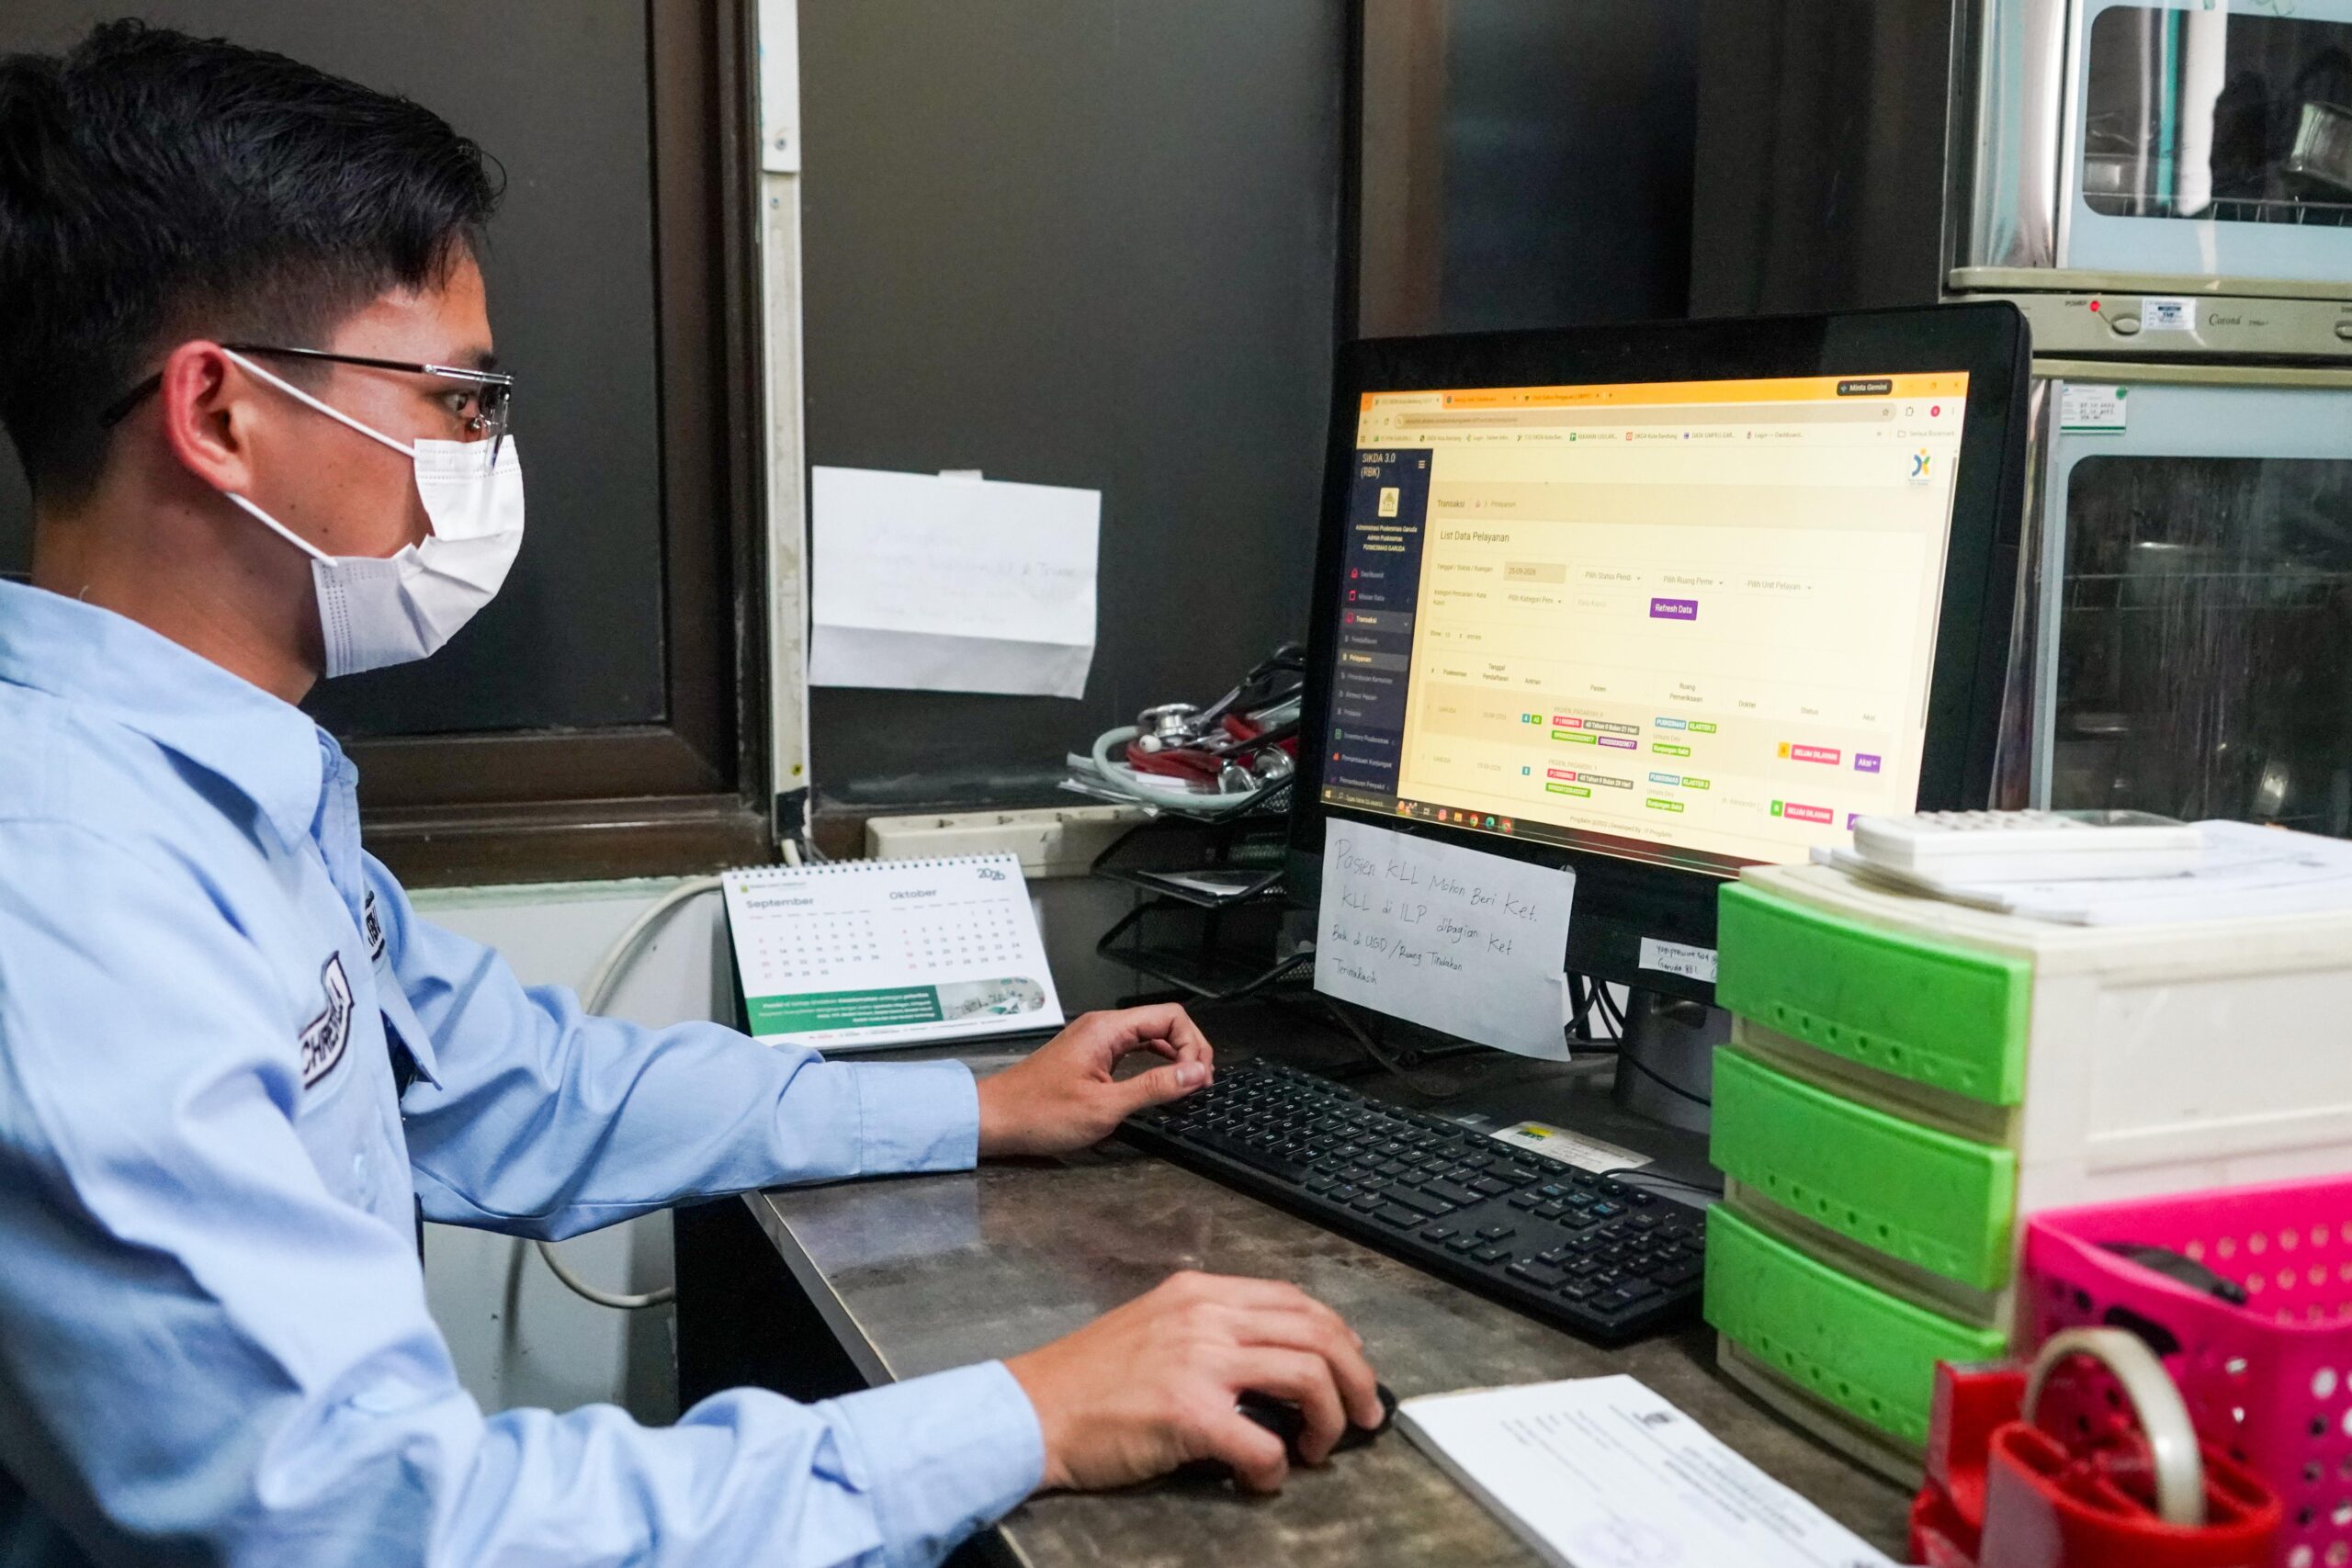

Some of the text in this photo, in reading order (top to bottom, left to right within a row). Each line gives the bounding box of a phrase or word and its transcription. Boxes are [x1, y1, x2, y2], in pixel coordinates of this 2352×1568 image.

[1849, 383, 1888, 392] Minta Gemini
[1362, 452, 1396, 464] SIKDA 3.0
[1361, 466, 1381, 479] (RBK)
[1437, 499, 1465, 508] Transaksi
[1440, 530, 1510, 544] List Data Pelayanan
[1598, 571, 1615, 580] Status
[1676, 576, 1695, 587] Ruang
[1520, 594, 1541, 604] Kategori
[1655, 604, 1692, 615] Refresh Data
[1488, 662, 1506, 671] Tanggal
[1679, 682, 1696, 692] Ruang
[1738, 700, 1757, 708] Dokter
[977, 867, 1006, 882] 2026
[1335, 838, 1376, 877] Pasien
[1385, 859, 1419, 886] KLL
[1429, 875, 1465, 896] Mohon
[1470, 887, 1498, 906] Beri
[889, 889, 937, 900] Oktober
[746, 897, 814, 909] September
[1340, 885, 1513, 956] KLL di ILP dibagian Ket
[1365, 935, 1388, 953] UGD
[1426, 951, 1464, 972] Tindakan
